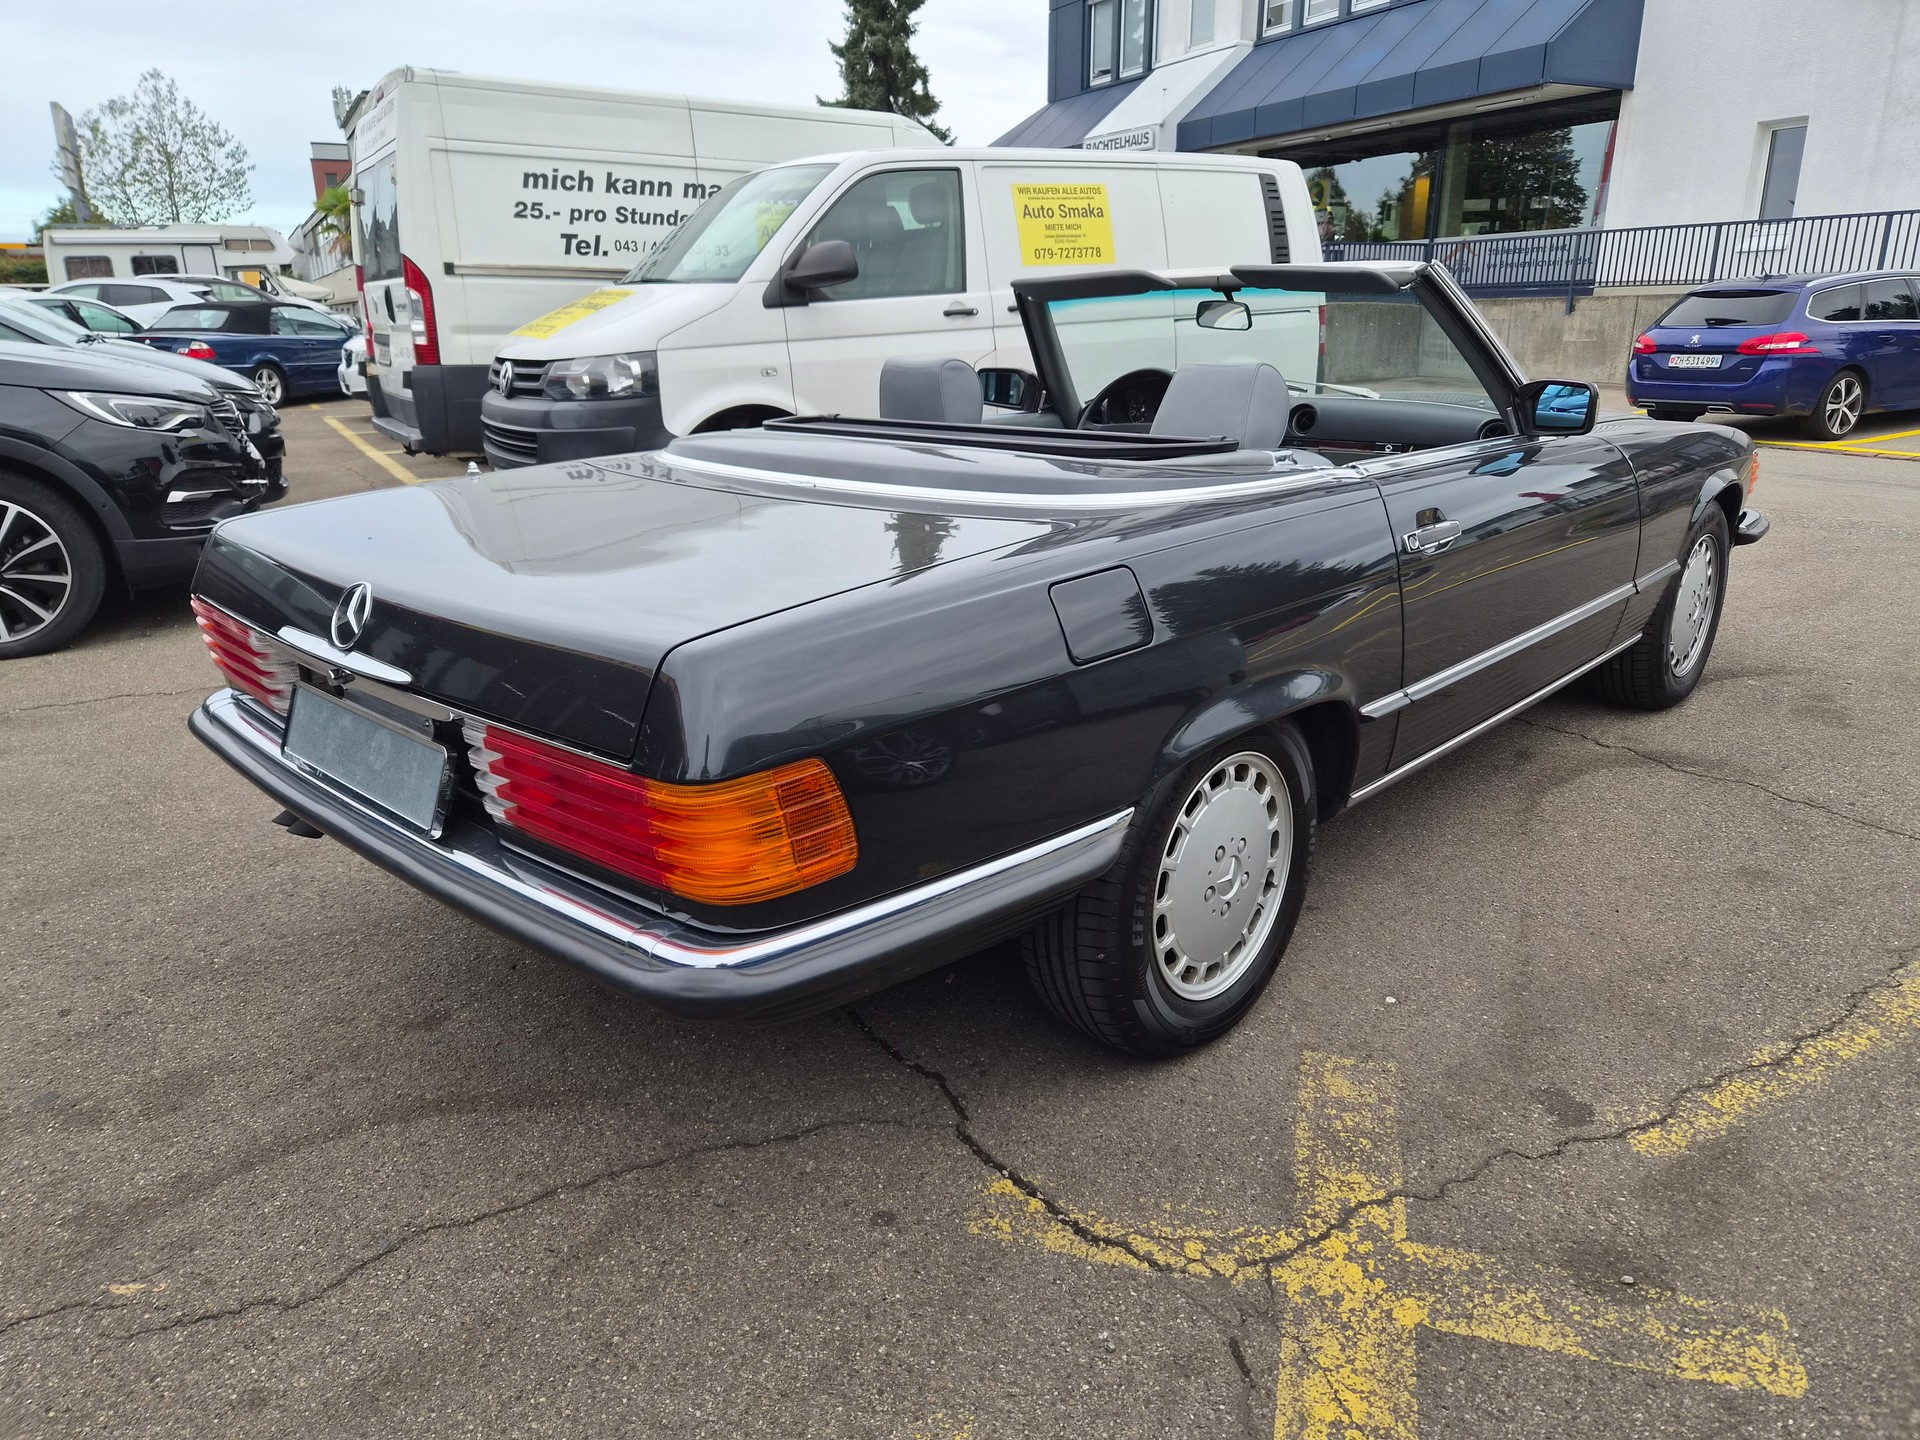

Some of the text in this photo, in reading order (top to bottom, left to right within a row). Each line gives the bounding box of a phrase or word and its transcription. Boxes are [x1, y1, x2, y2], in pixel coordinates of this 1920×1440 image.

[522, 168, 594, 193] mich
[605, 171, 673, 198] kann
[1017, 187, 1102, 195] WIR KAUFEN ALLE AUTOS
[513, 201, 561, 220] 25.-
[569, 207, 607, 225] pro
[1023, 203, 1104, 219] Auto Smaka
[1065, 223, 1082, 231] MICH
[560, 233, 609, 257] Tel.
[614, 240, 639, 252] 043
[1034, 247, 1102, 260] 079-7273778
